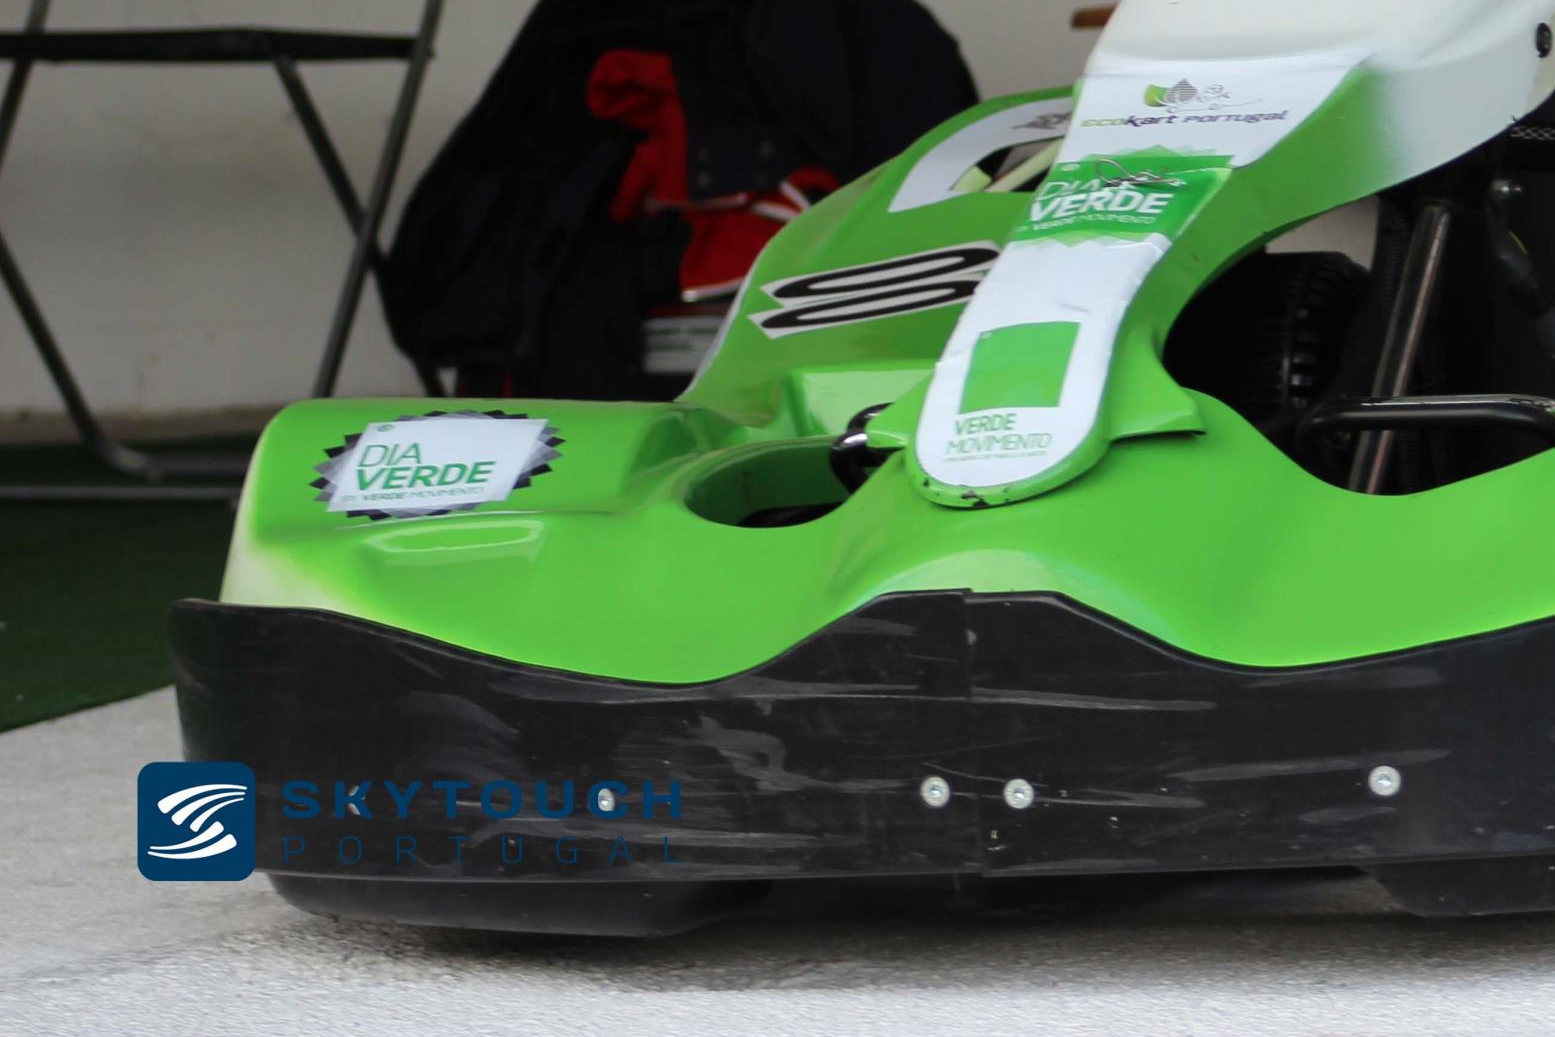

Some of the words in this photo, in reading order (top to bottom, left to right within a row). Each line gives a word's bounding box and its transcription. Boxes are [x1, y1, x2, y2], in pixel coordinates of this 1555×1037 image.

[1081, 115, 1178, 127] ecokart
[1030, 190, 1174, 222] VERDE
[954, 413, 1017, 437] VERDE
[358, 442, 422, 468] DIA
[944, 433, 1053, 455] MOVIMENTO
[355, 461, 496, 490] VERDE
